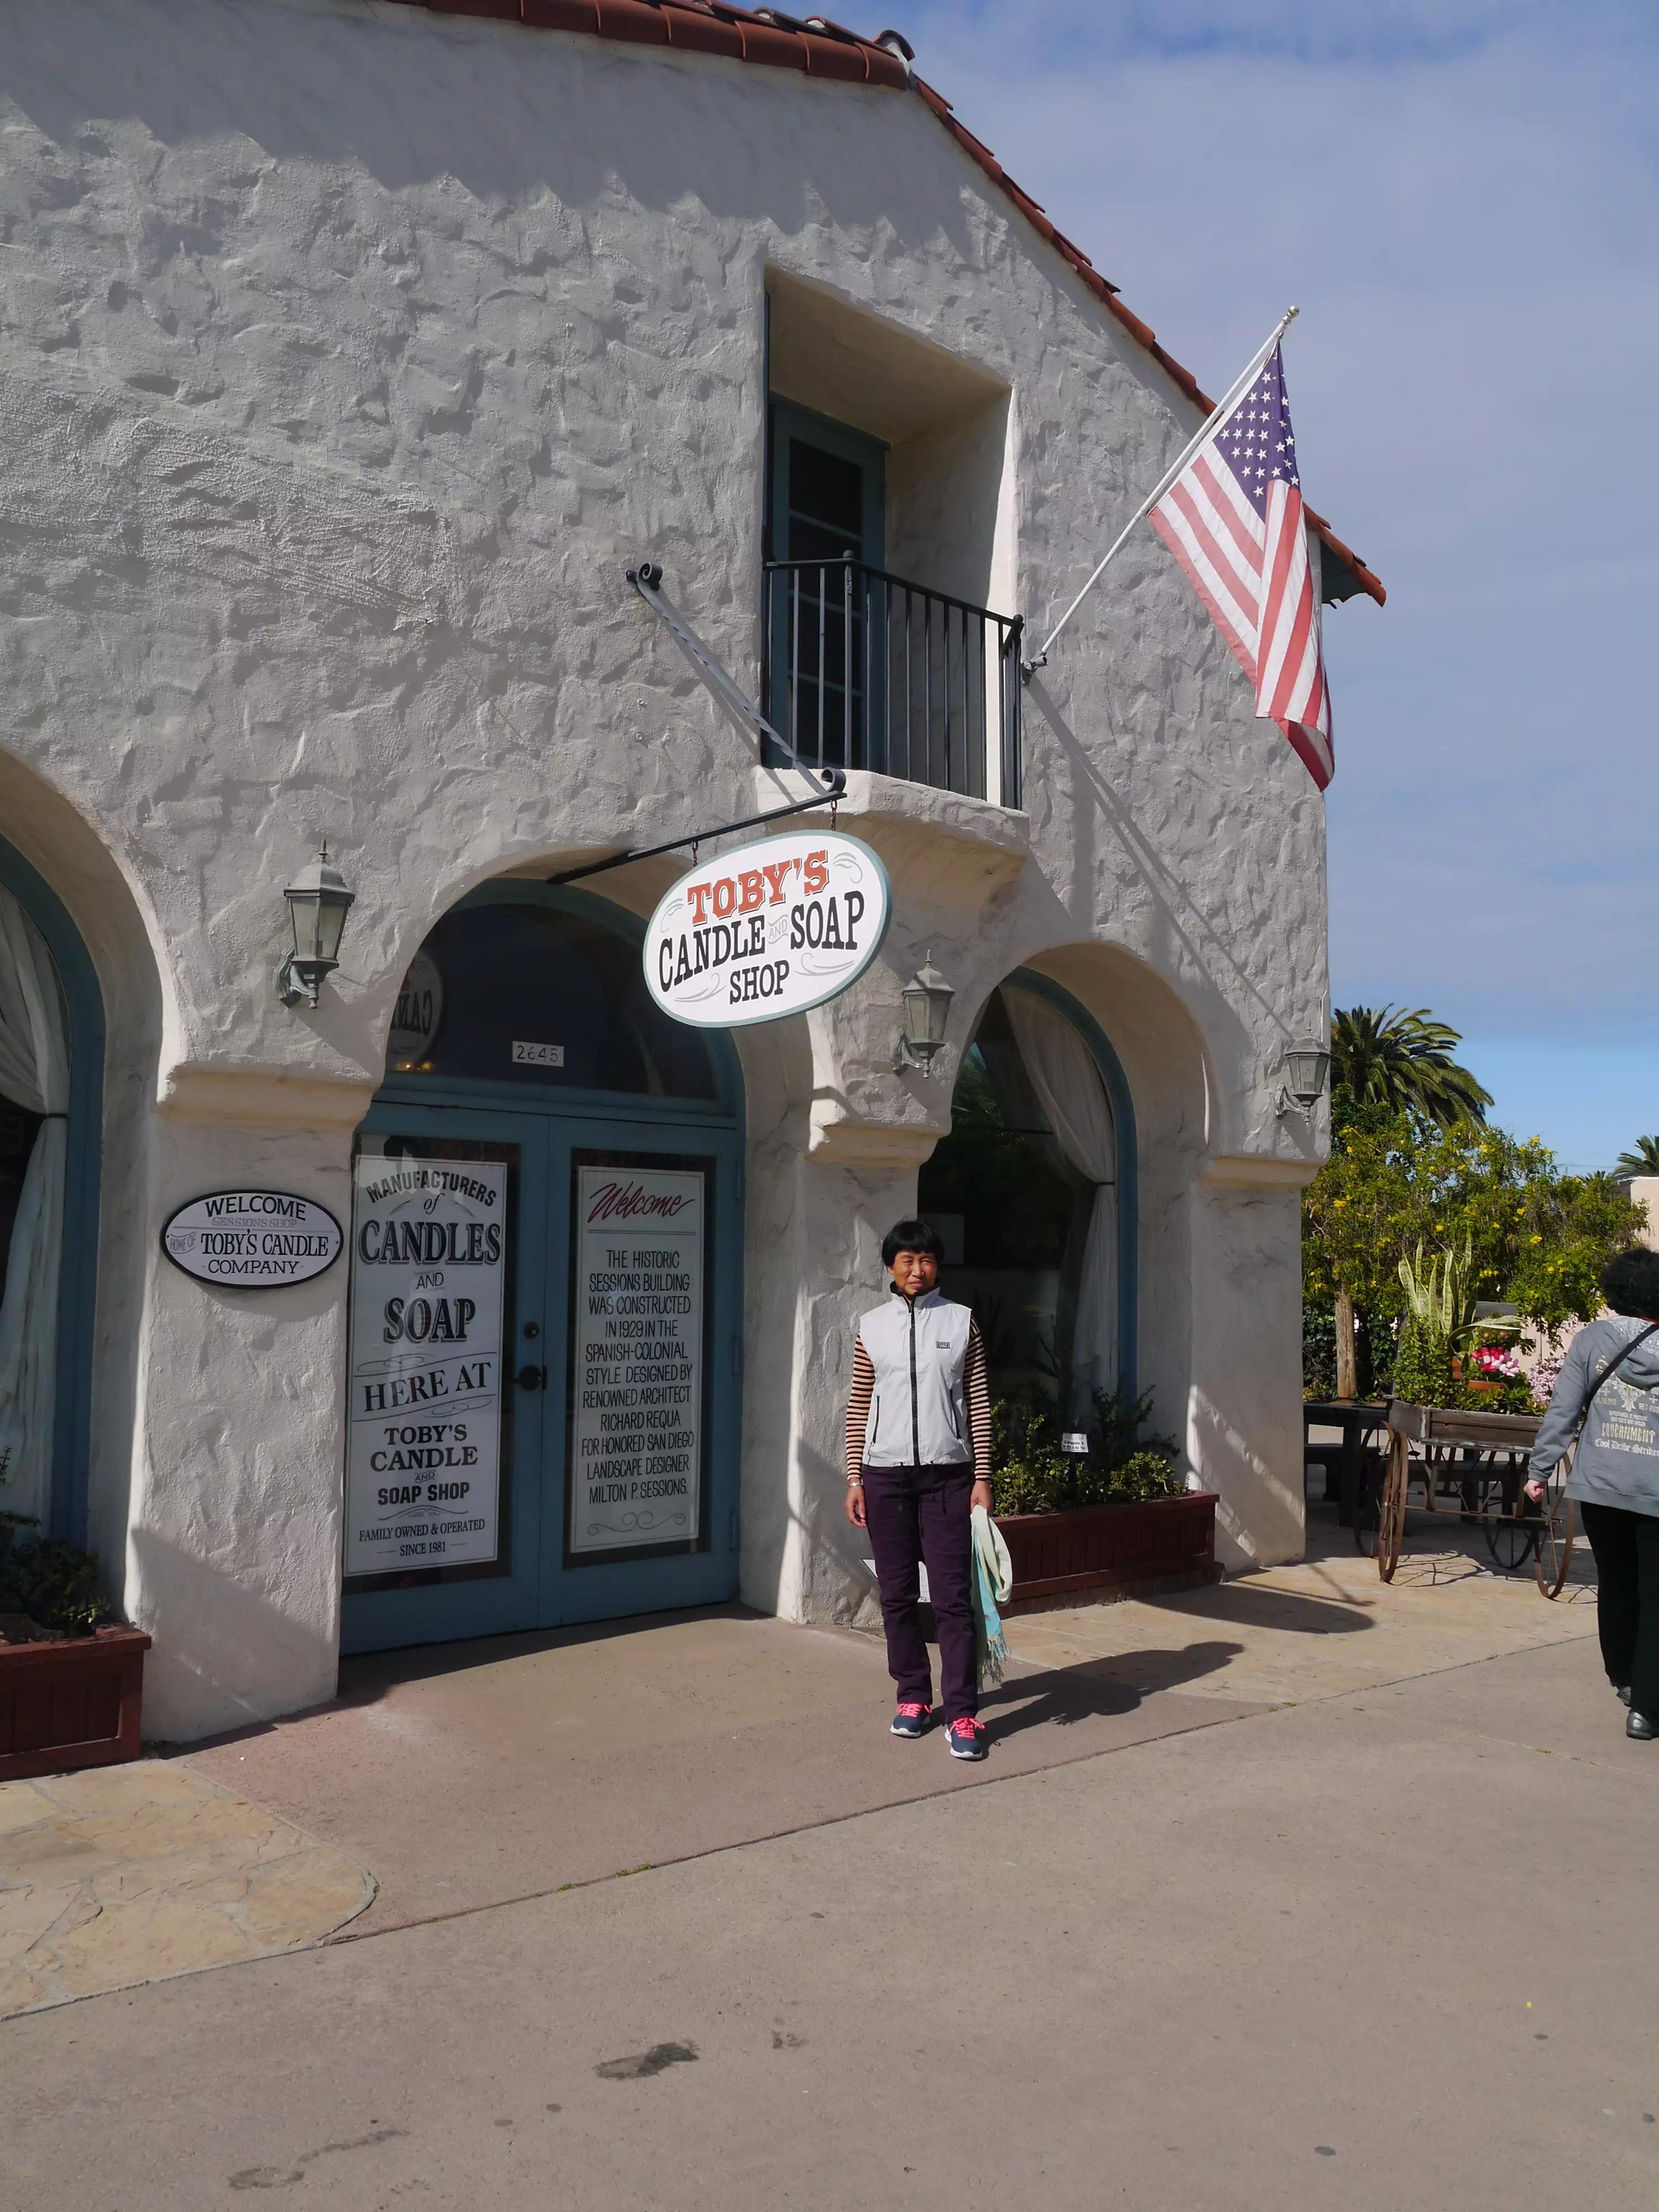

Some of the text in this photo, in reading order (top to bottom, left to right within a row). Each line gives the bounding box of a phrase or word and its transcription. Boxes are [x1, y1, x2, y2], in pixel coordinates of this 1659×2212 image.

[687, 850, 829, 926] TOBY'S
[659, 890, 865, 992] CANDLE AND SOAP
[729, 959, 790, 1004] SHOP
[517, 1045, 558, 1062] 2645
[366, 1170, 497, 1207] MANUFACTURERS
[205, 1196, 306, 1221] WELCOME
[423, 1193, 445, 1214] of
[587, 1181, 695, 1223] Welcome
[212, 1217, 298, 1228] SESSIONS SHOP
[170, 1228, 328, 1256] HOME OF TOBY'S CANDLE
[359, 1219, 501, 1265] CANDLES
[208, 1259, 300, 1274] COMPANY
[606, 1250, 680, 1269] THE HISTORIC
[416, 1272, 444, 1290] AND
[589, 1273, 690, 1292] SESSIONS BUILDING
[589, 1295, 691, 1315] WAS CONSTRUCTED
[383, 1297, 476, 1344] SOAP
[606, 1319, 678, 1338] IN 1929 IN THE
[586, 1342, 688, 1363] SPANISH-COLONIAL
[586, 1364, 693, 1385] STYLE DESIGNED BY
[363, 1362, 491, 1412] HERE AT
[583, 1385, 692, 1408] RENOWNED ARCHITECT
[601, 1410, 681, 1432] RICHARD REQUA
[384, 1424, 467, 1445] TOBY'S
[581, 1431, 694, 1457] FOR HONORED SAN DIEGO
[370, 1446, 478, 1472] CANDLE
[587, 1454, 690, 1480] LANDSCAPE DESIGNER
[415, 1472, 435, 1482] AND
[378, 1482, 469, 1505] SOAP SHOP
[589, 1484, 627, 1504] MILTON
[640, 1478, 688, 1499] SESSIONS.
[359, 1519, 485, 1542] FAMILY OWNED & OPERATED
[400, 1541, 446, 1557] SINCE 1981
